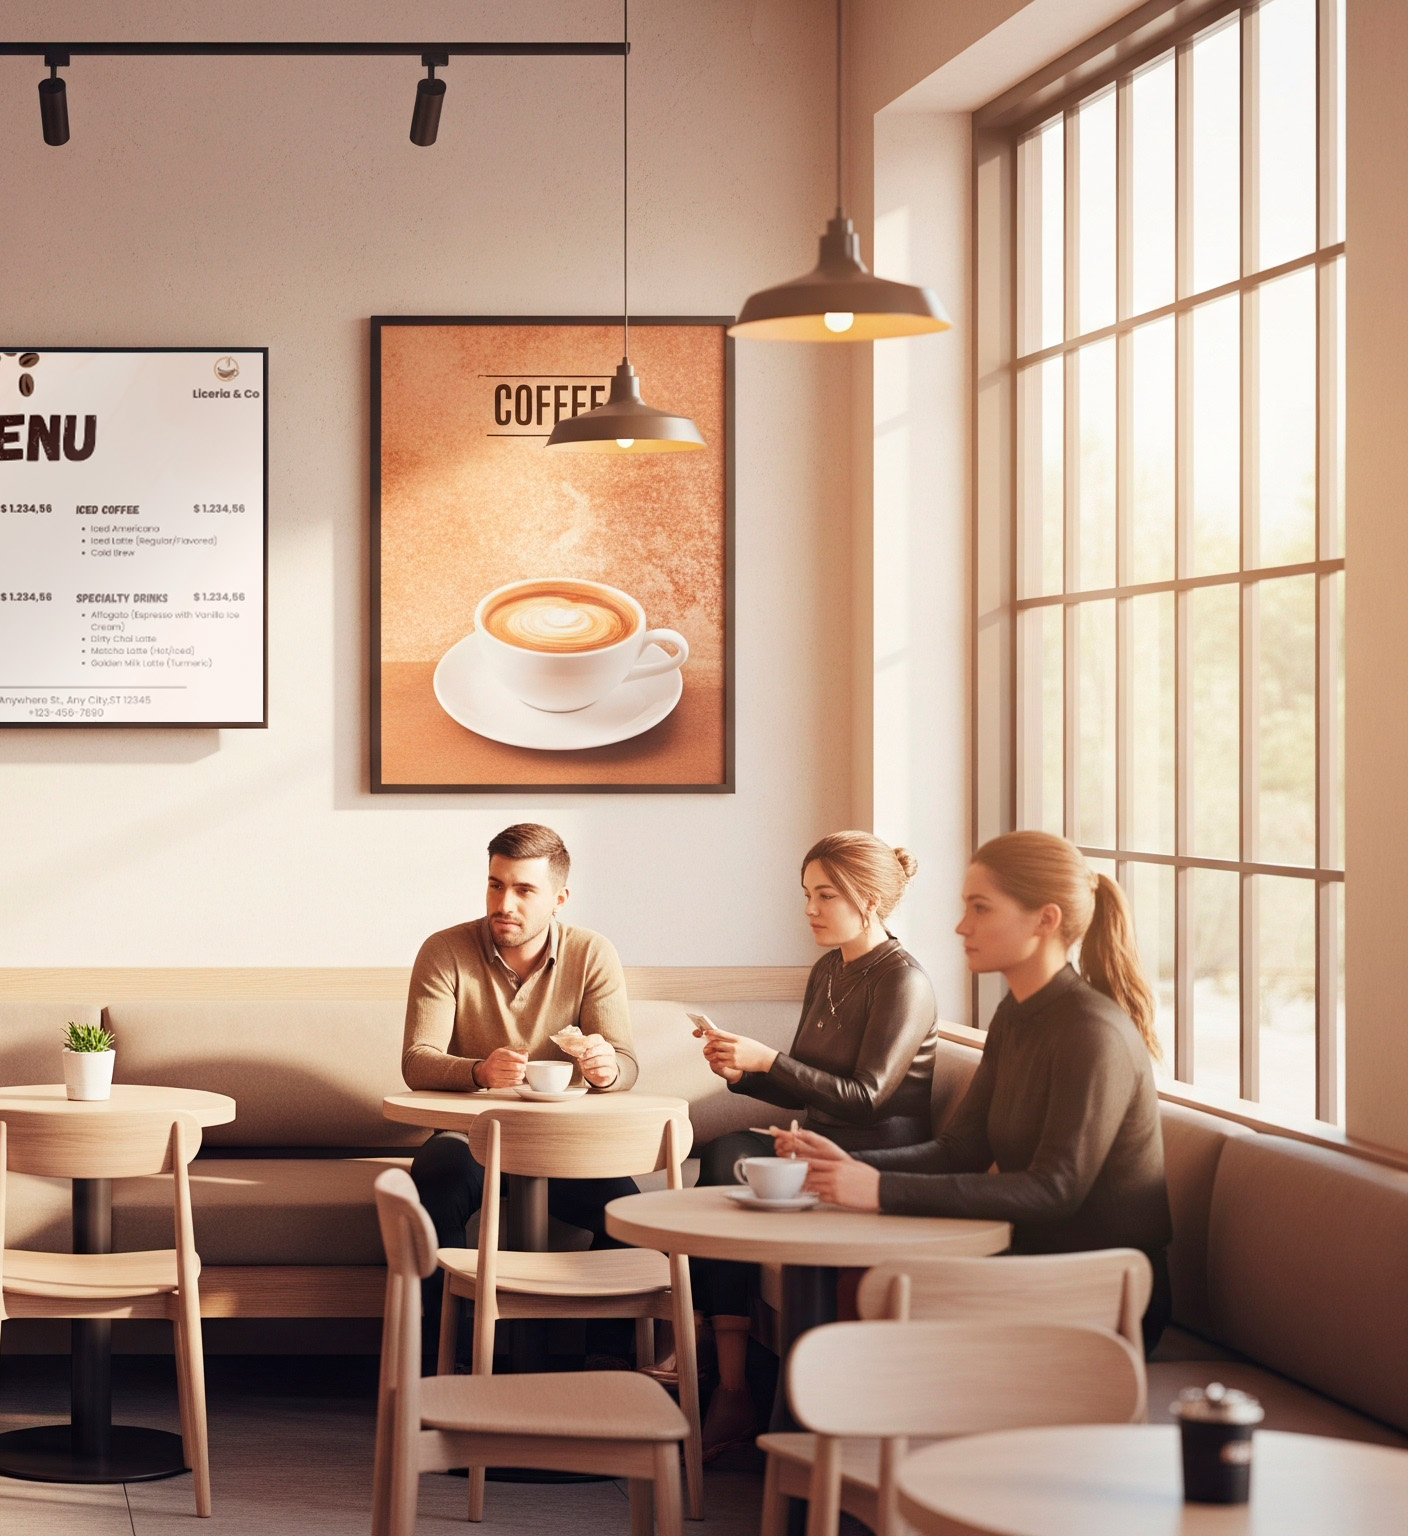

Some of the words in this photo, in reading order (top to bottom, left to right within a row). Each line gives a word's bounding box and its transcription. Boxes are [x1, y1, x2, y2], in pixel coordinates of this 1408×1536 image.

[193, 389, 229, 399] Liceria
[232, 389, 242, 399] &
[244, 389, 260, 399] Co
[76, 505, 98, 515] ICED
[102, 505, 140, 515] COFFEE
[90, 525, 110, 533] Iced
[112, 525, 160, 533] Americano
[90, 549, 112, 557] Cold
[113, 549, 135, 557] Brew
[76, 593, 130, 603] SPECIALTY
[133, 593, 168, 603] DRINKS
[50, 695, 64, 706] St.,
[66, 695, 86, 707] Any
[87, 695, 121, 707] City,ST
[123, 695, 151, 705] 12345
[28, 708, 105, 718] +123-456-7890
